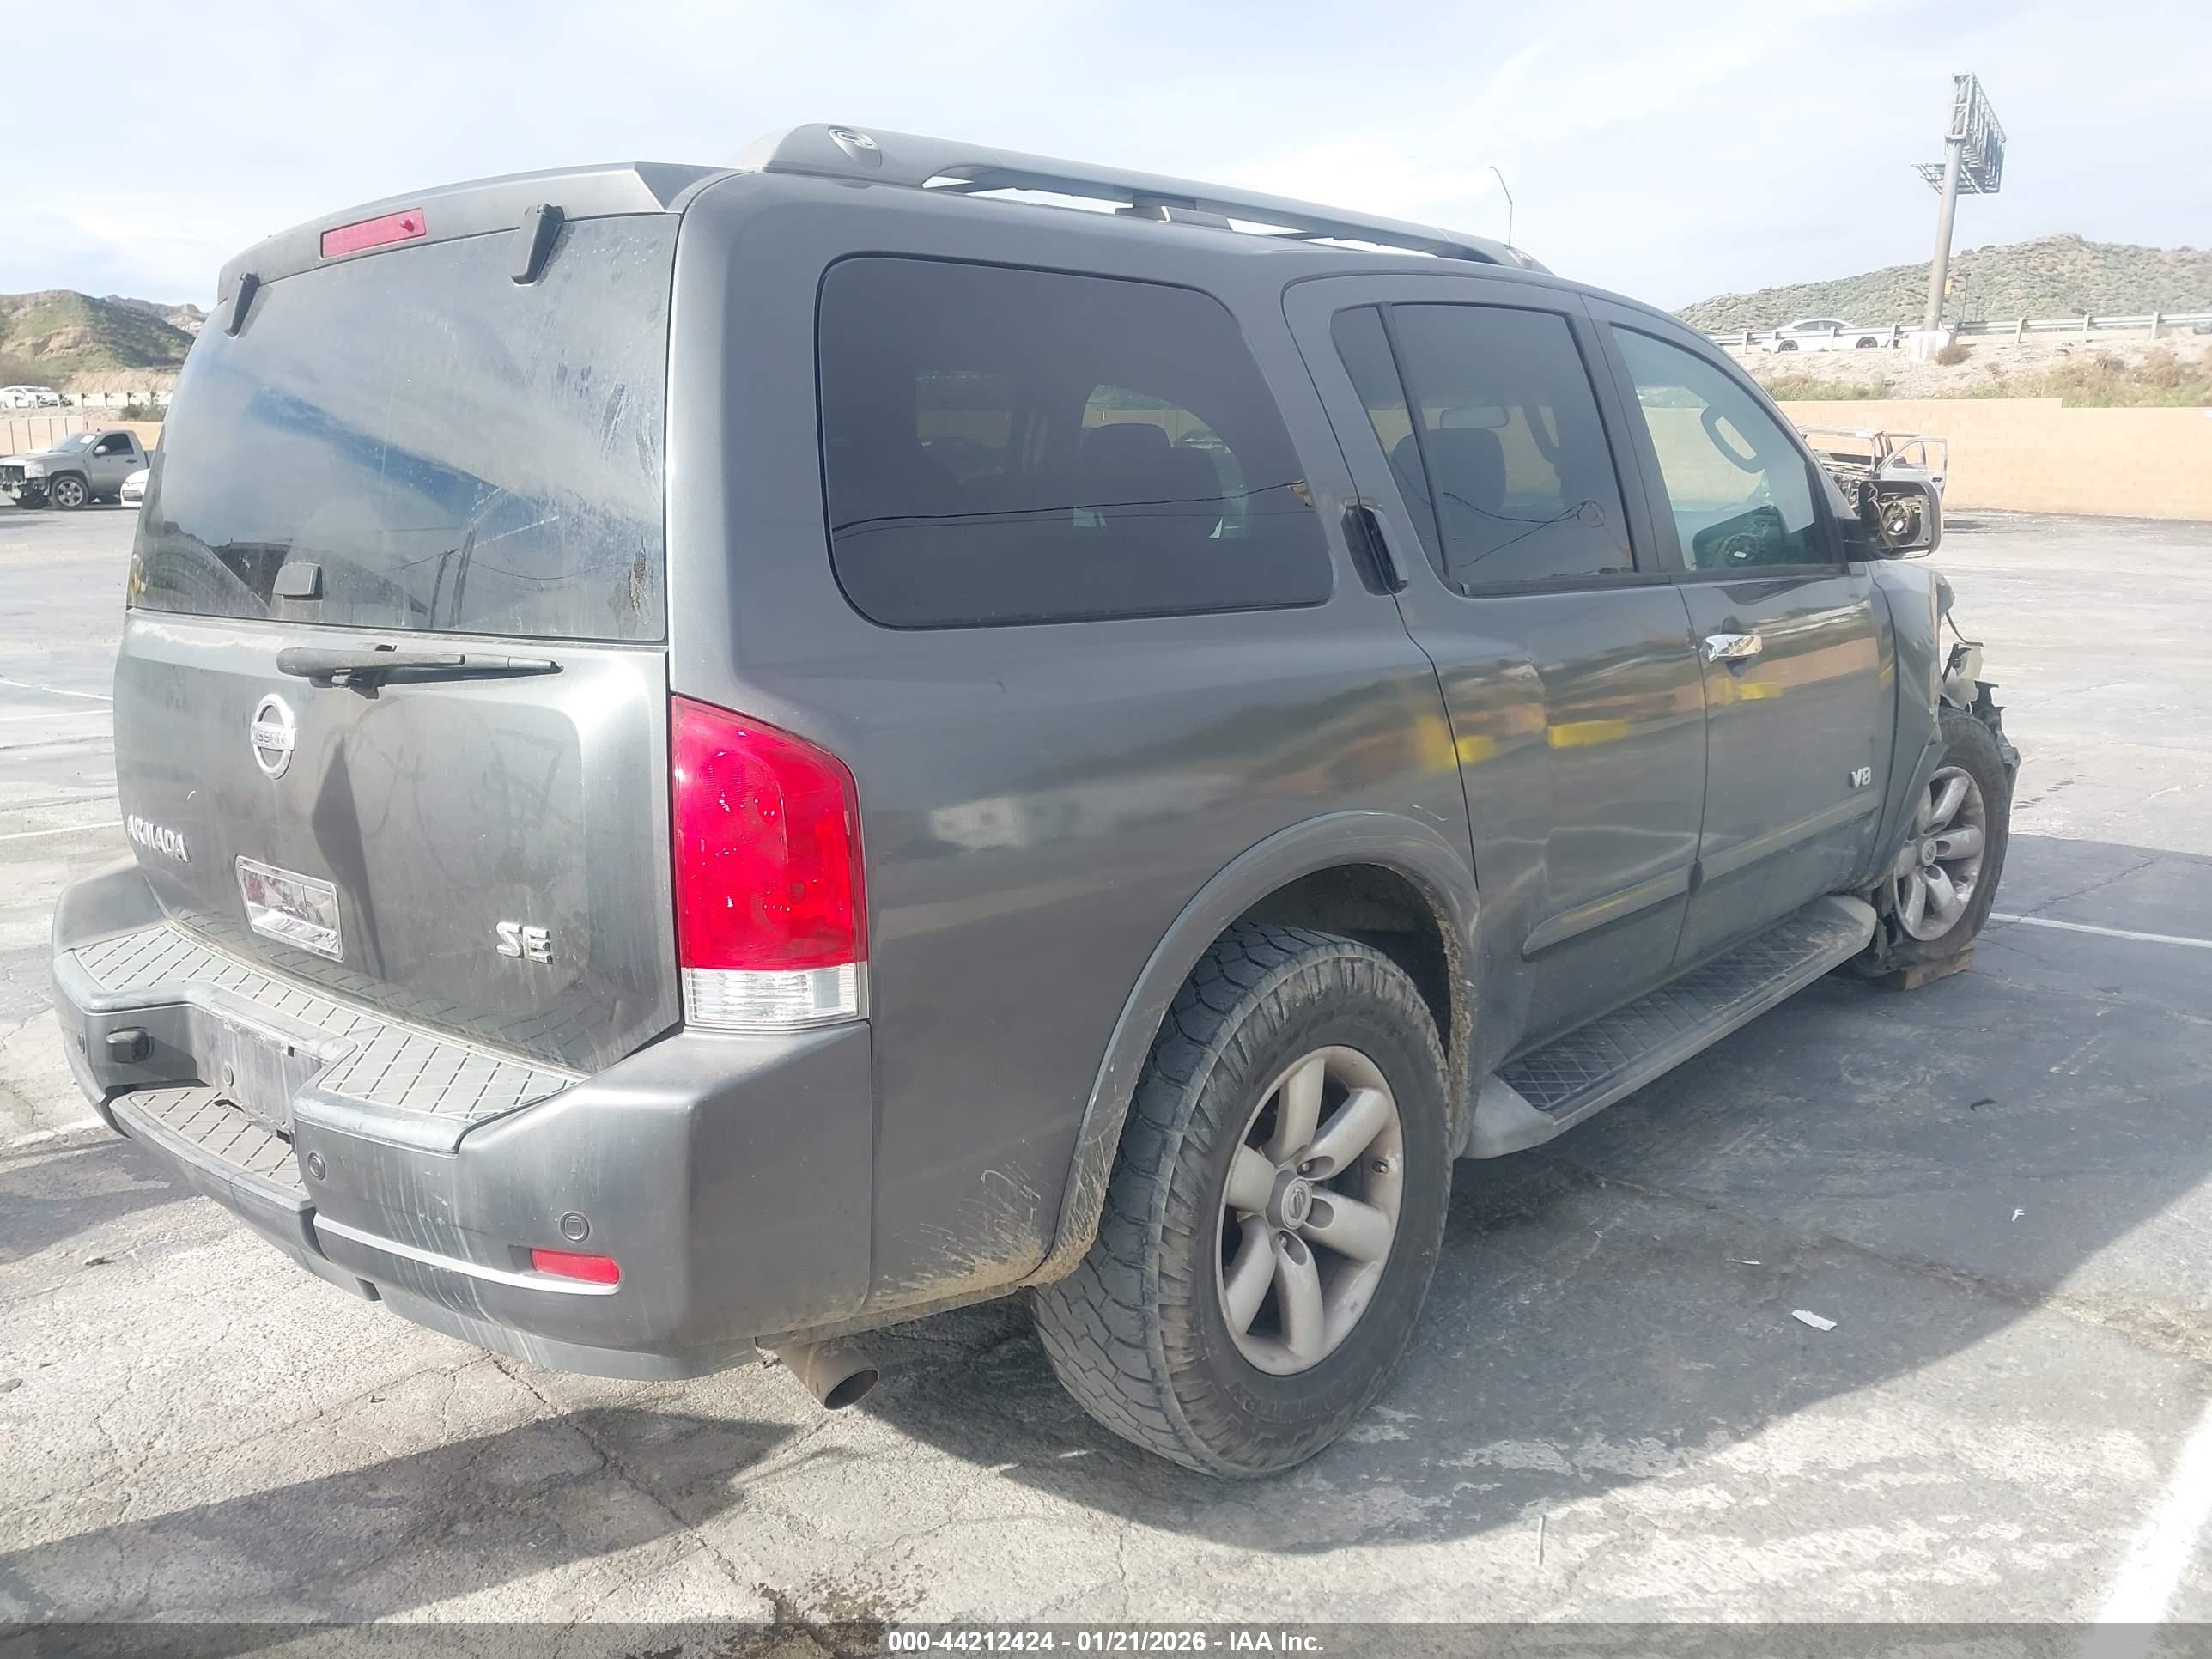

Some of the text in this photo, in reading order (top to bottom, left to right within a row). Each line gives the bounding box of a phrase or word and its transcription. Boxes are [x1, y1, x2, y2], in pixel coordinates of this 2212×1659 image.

[1850, 766, 1872, 788] V8
[127, 814, 190, 863] ARMADA
[495, 921, 553, 964] SE
